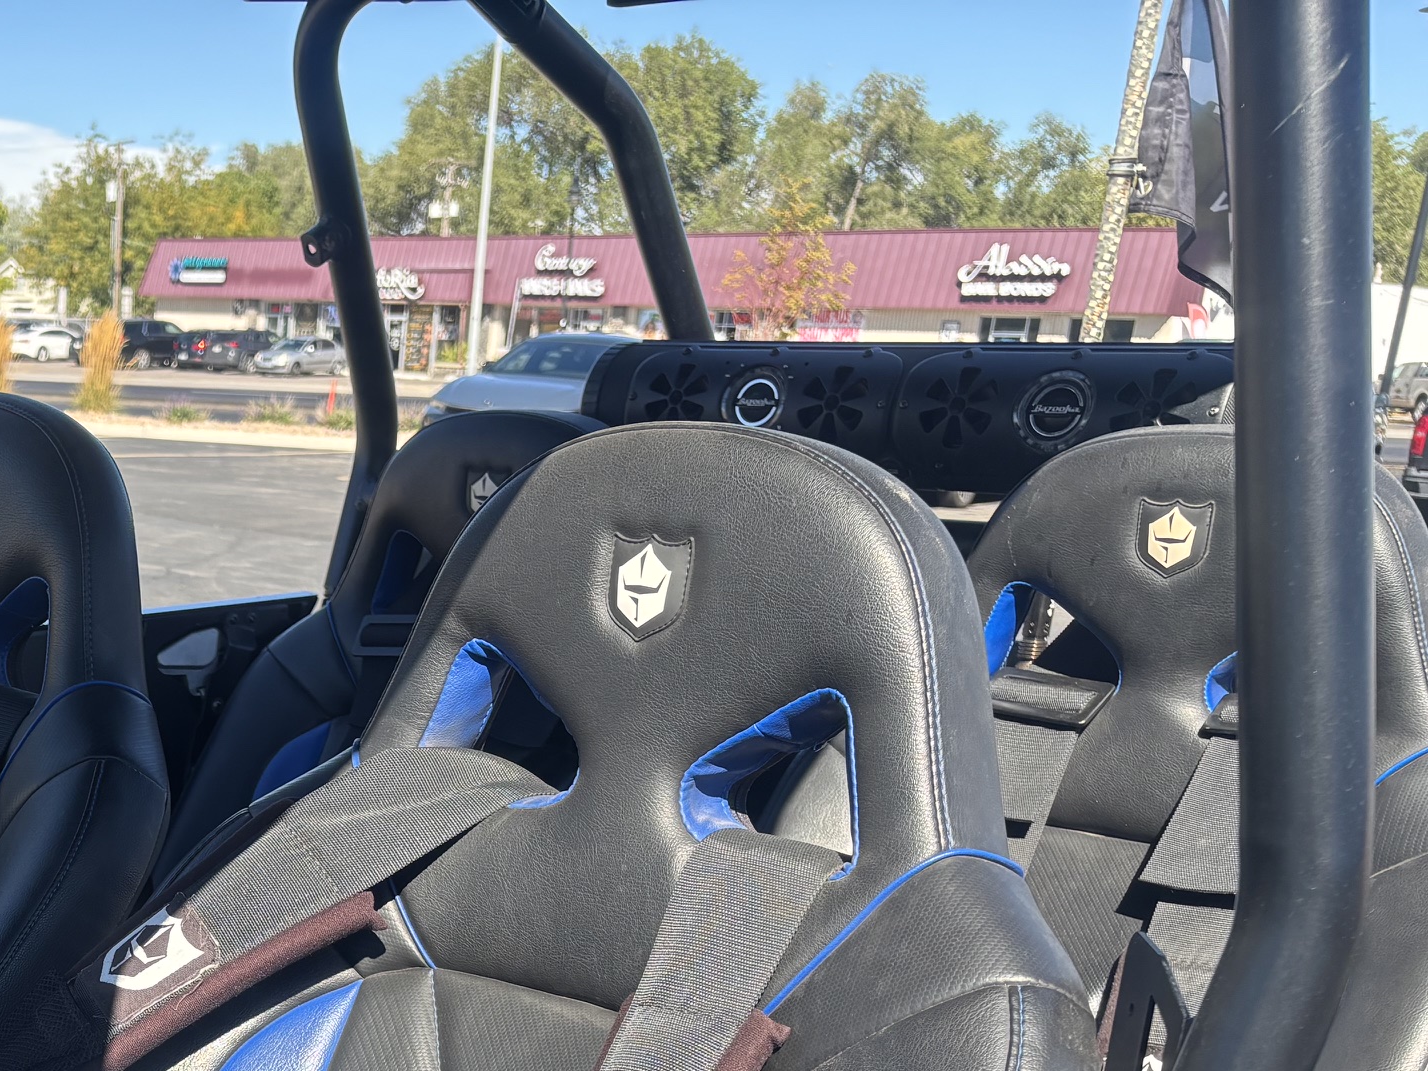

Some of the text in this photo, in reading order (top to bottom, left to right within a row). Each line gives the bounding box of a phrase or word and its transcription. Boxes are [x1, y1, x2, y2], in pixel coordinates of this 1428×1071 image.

[957, 242, 1071, 283] Aladdin
[999, 281, 1057, 297] BONDS
[1031, 404, 1081, 414] Bazooka
